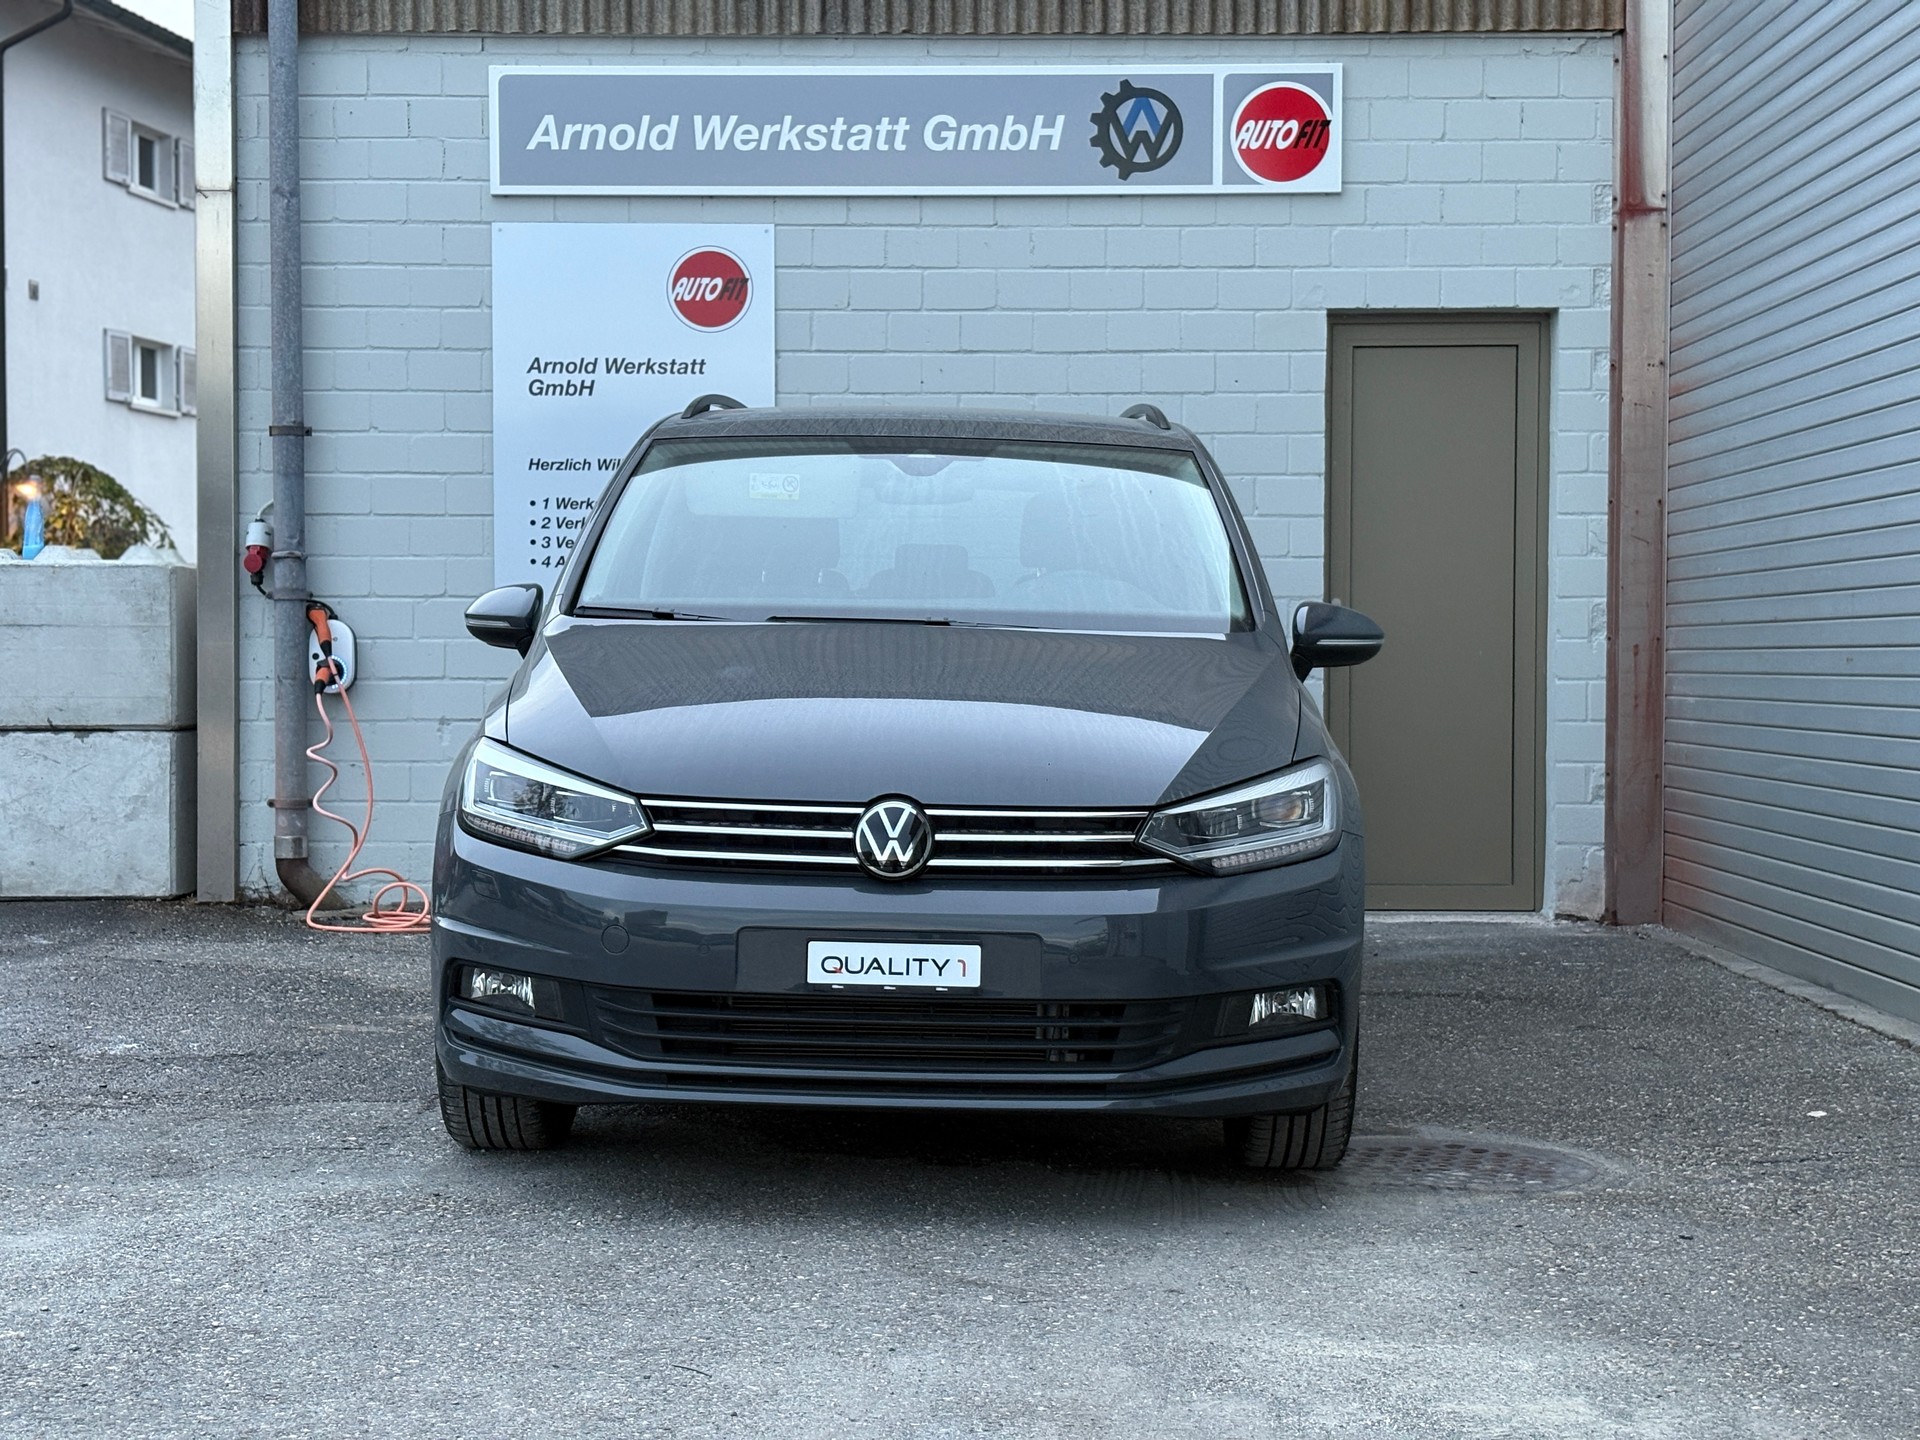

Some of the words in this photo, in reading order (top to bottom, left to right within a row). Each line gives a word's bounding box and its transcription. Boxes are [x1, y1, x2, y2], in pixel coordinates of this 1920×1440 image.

[526, 114, 680, 151] Arnold
[692, 114, 910, 151] Werkstatt
[922, 113, 1066, 152] GmbH
[1236, 119, 1332, 150] AUTOFIT
[672, 276, 750, 302] AUTOFIT
[526, 357, 598, 375] Arnold
[604, 357, 706, 375] Werkstatt
[528, 379, 595, 396] GmbH
[528, 458, 592, 471] Herzlich
[597, 458, 623, 471] Wil
[542, 497, 550, 510] 1
[541, 516, 551, 529] 2
[541, 536, 551, 549] 3
[541, 555, 551, 568] 4
[820, 955, 951, 977] QUALITY
